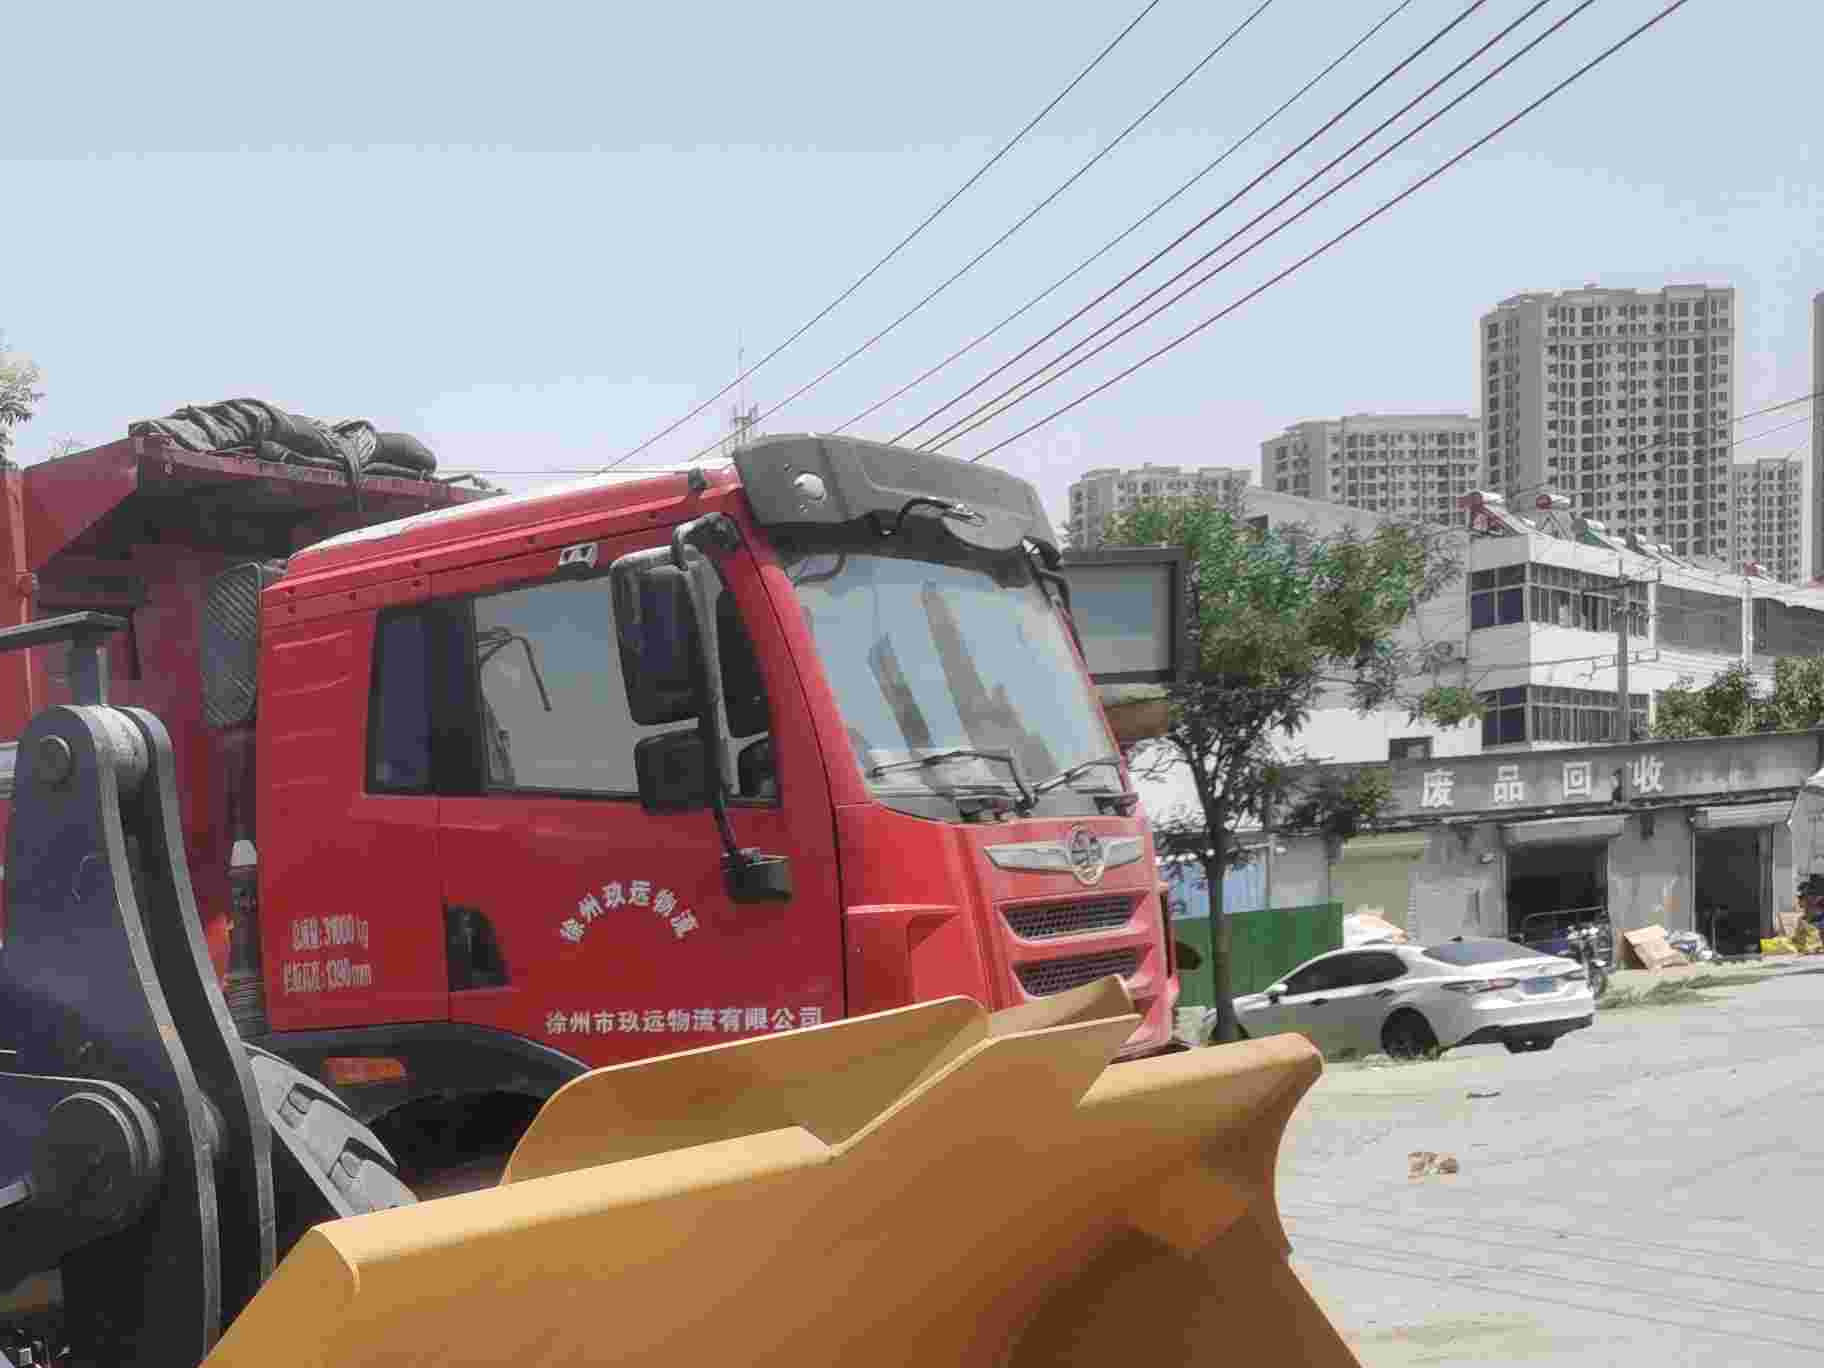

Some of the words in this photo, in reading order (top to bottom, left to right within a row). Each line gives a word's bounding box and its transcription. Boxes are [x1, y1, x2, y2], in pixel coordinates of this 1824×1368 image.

[1421, 755, 1664, 808] 废品回收
[560, 879, 699, 941] 徐州玖远物流
[545, 1006, 824, 1034] 徐州市玖远物流有限公司
